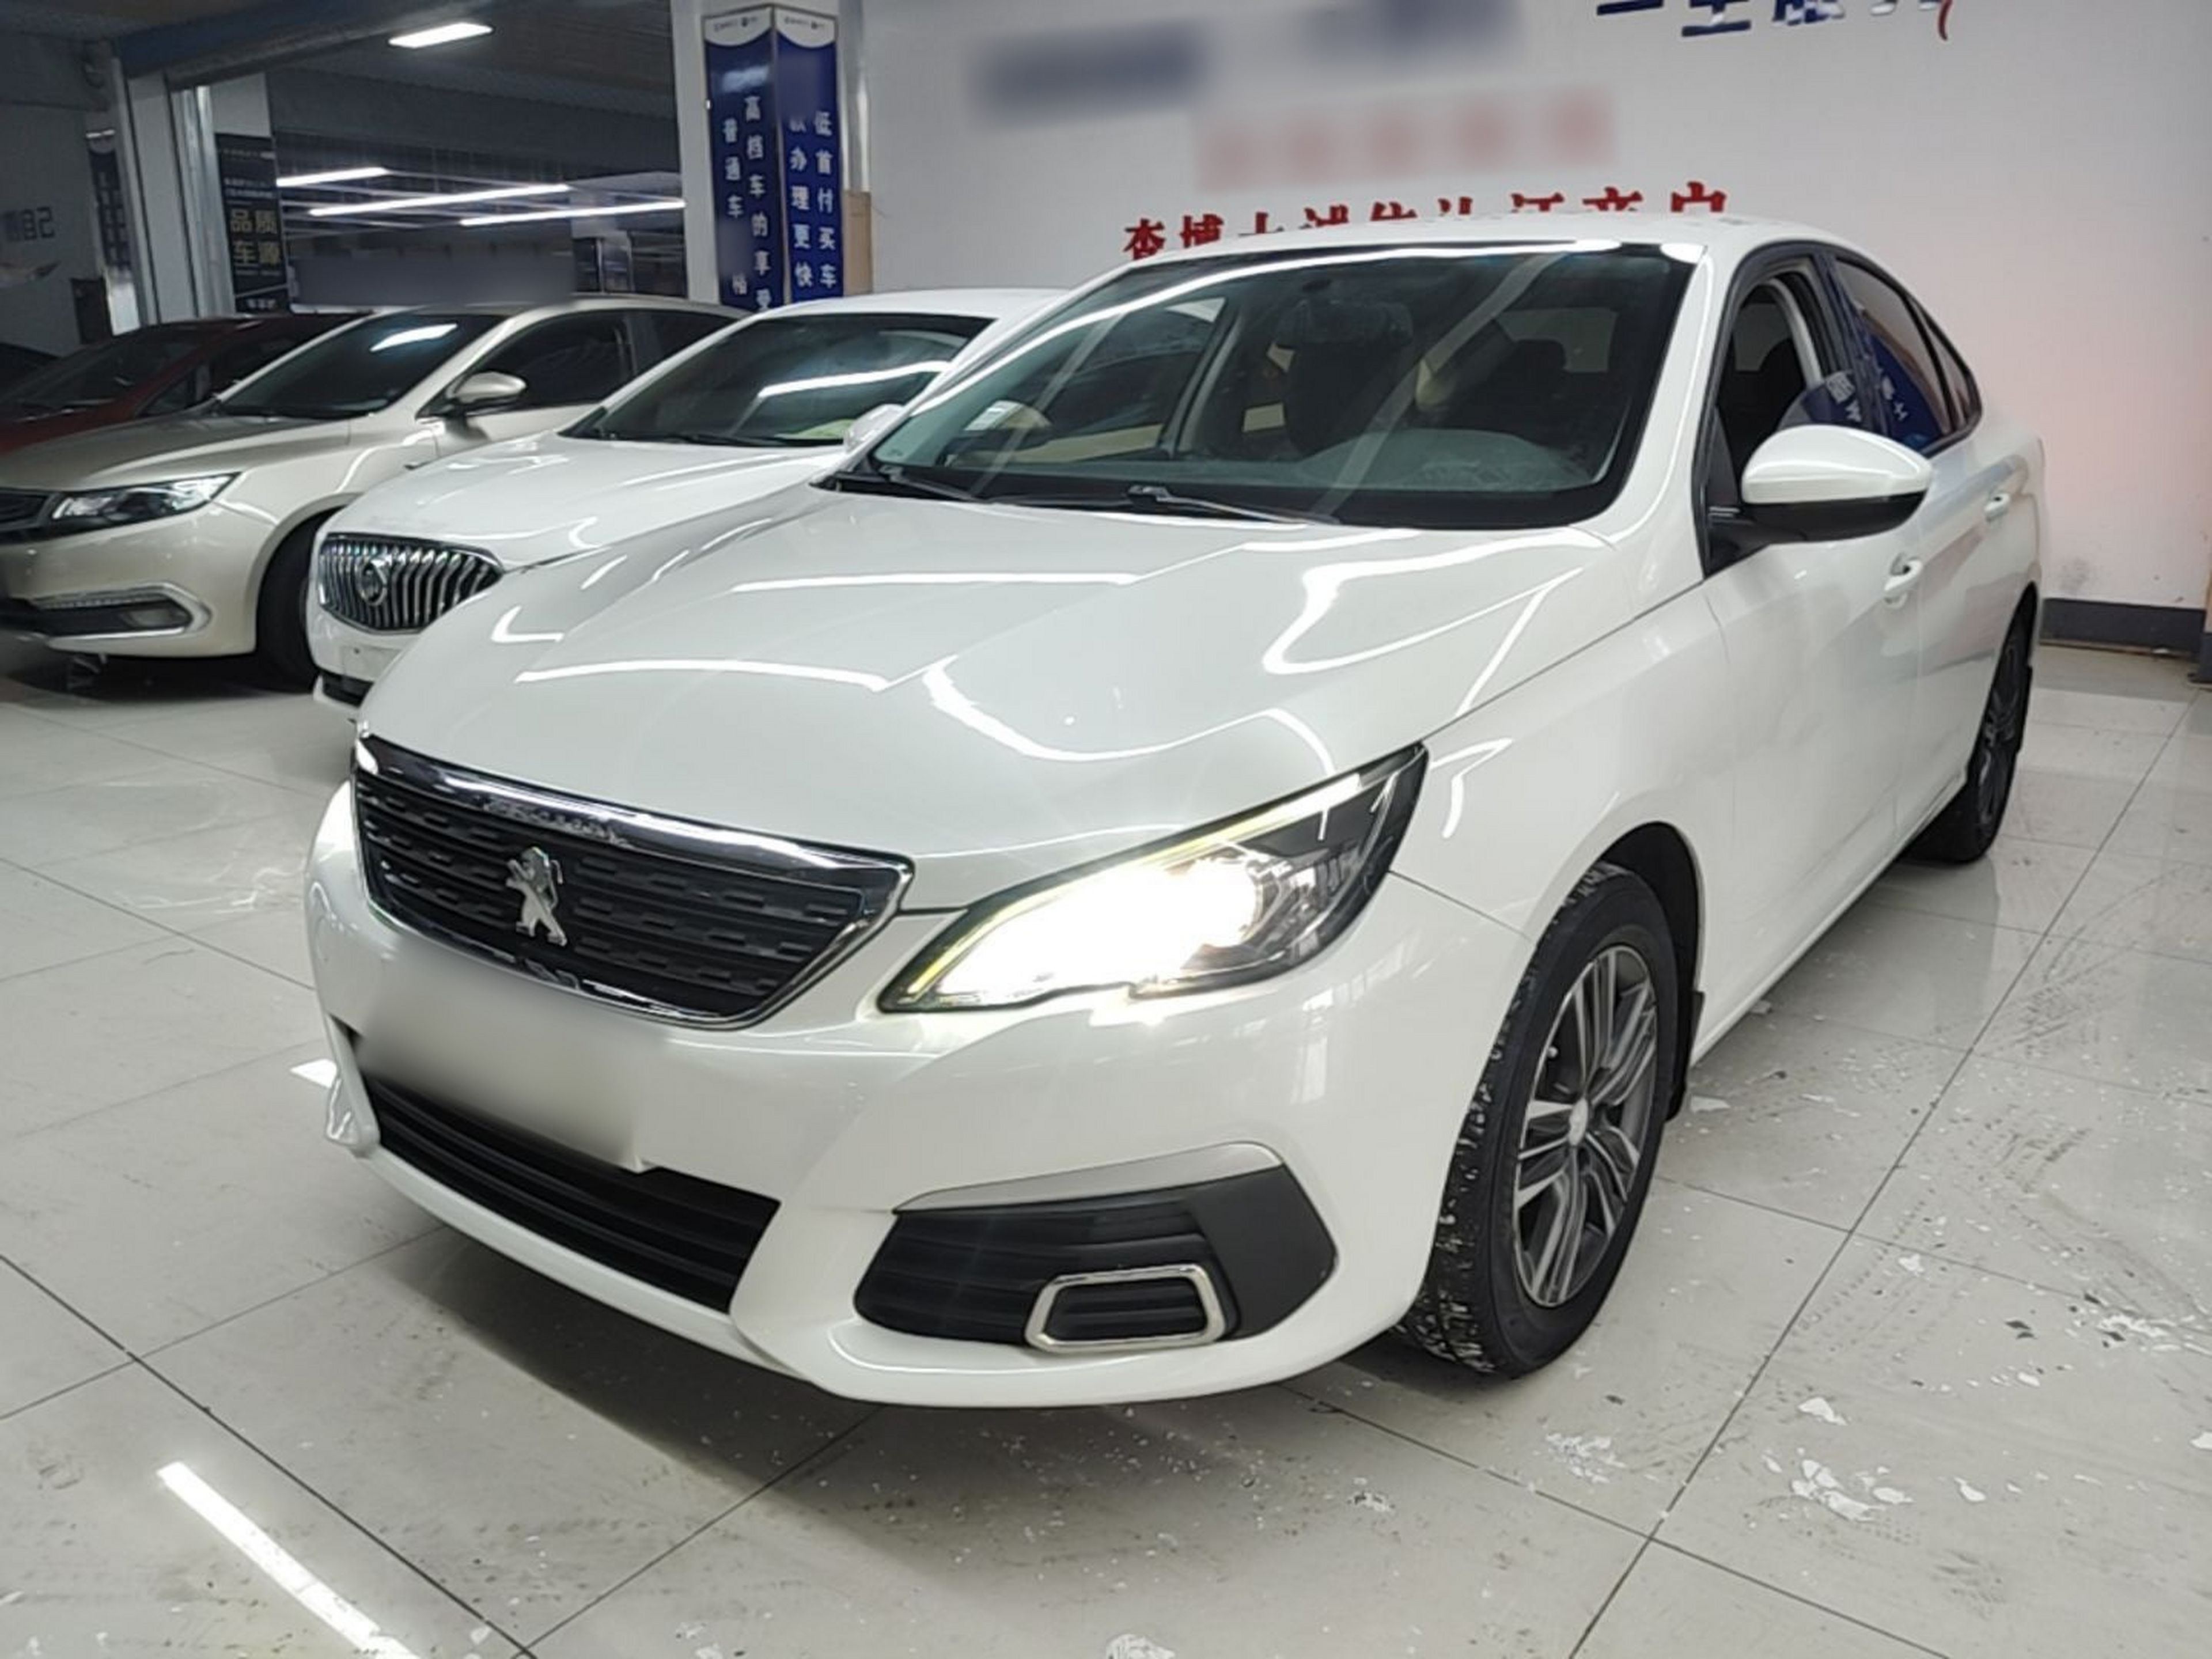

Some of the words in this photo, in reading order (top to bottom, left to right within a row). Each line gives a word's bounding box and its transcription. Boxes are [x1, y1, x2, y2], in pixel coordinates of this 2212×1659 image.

[722, 118, 747, 296] 普通车格
[814, 110, 836, 288] 低首付买车
